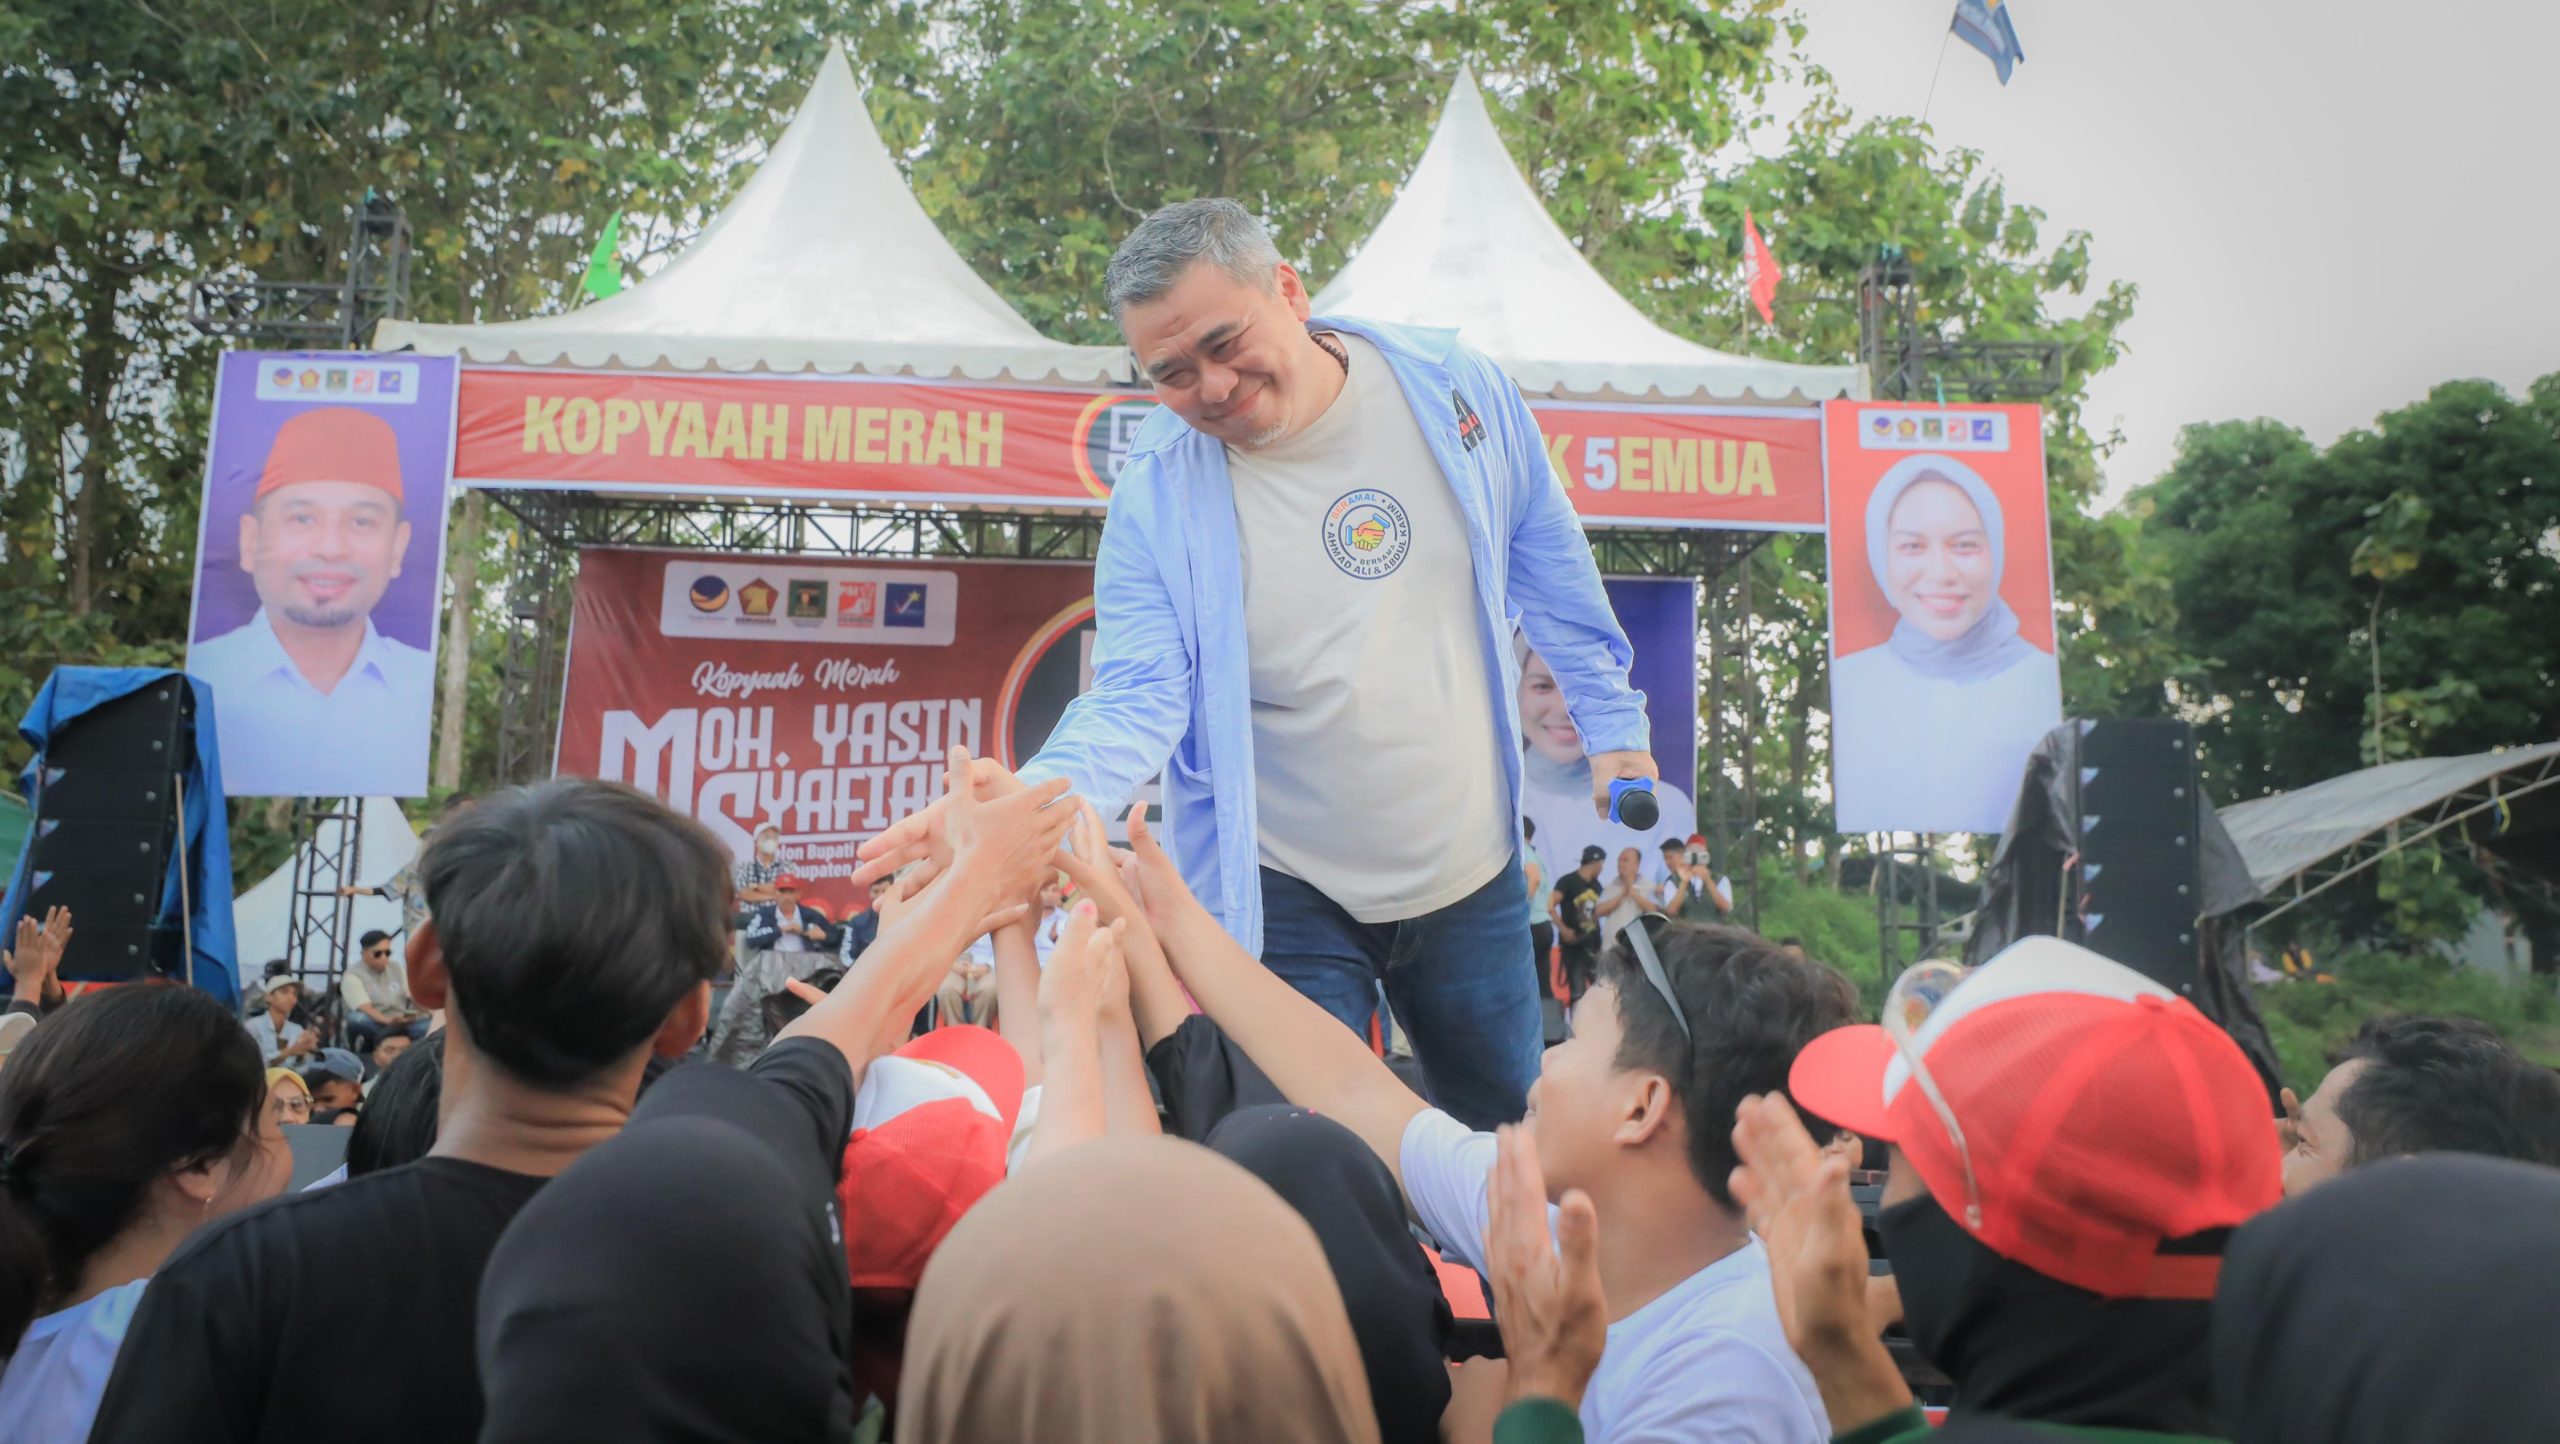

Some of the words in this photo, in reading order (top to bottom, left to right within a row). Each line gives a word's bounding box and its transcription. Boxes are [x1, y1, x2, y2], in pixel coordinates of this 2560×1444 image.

[522, 395, 789, 461] KOPYAAH
[802, 404, 1004, 468] MERAH
[1583, 436, 1777, 497] 5EMUA
[1331, 493, 1377, 520] BERAMAL
[1387, 502, 1408, 537] KARIM
[1327, 531, 1352, 569] AHMAD
[1359, 544, 1396, 566] BERSAMA
[1383, 540, 1407, 571] ABDUL
[1353, 565, 1371, 575] ALI
[1373, 566, 1382, 575] &
[691, 660, 805, 699] Kopyaah
[814, 657, 900, 692] Merah
[812, 699, 982, 767] YASIN
[807, 841, 855, 863] Bupati
[794, 860, 852, 882] bupaten
